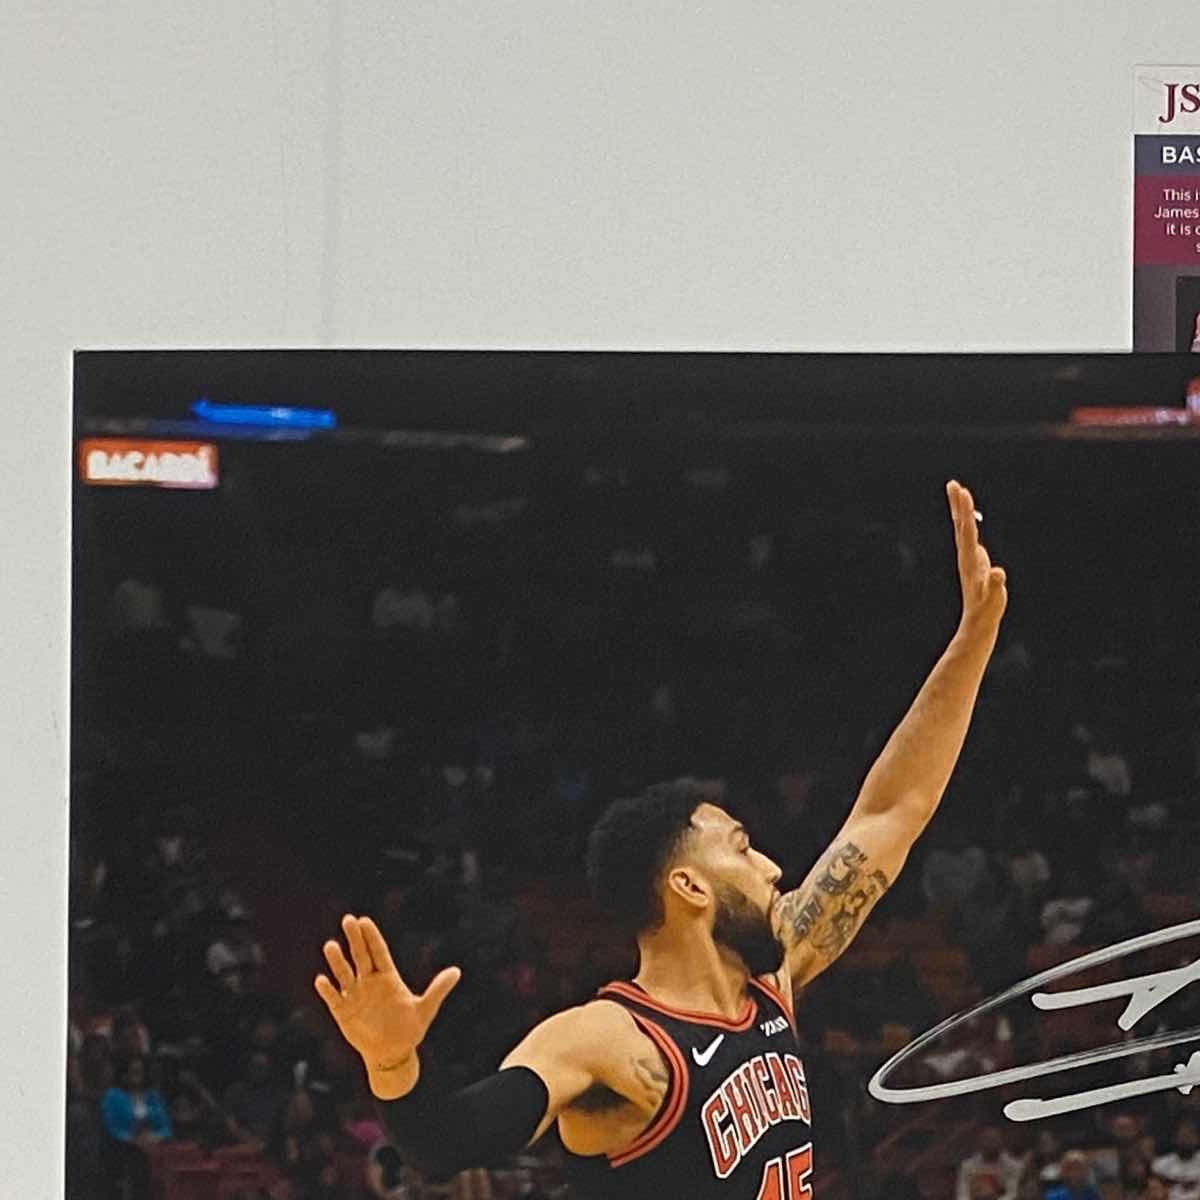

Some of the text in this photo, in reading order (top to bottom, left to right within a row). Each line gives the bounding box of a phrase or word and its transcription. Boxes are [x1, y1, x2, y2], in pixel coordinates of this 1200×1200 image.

[1163, 188, 1191, 201] This
[1154, 206, 1199, 219] James
[1166, 223, 1175, 236] it
[1180, 223, 1191, 236] is
